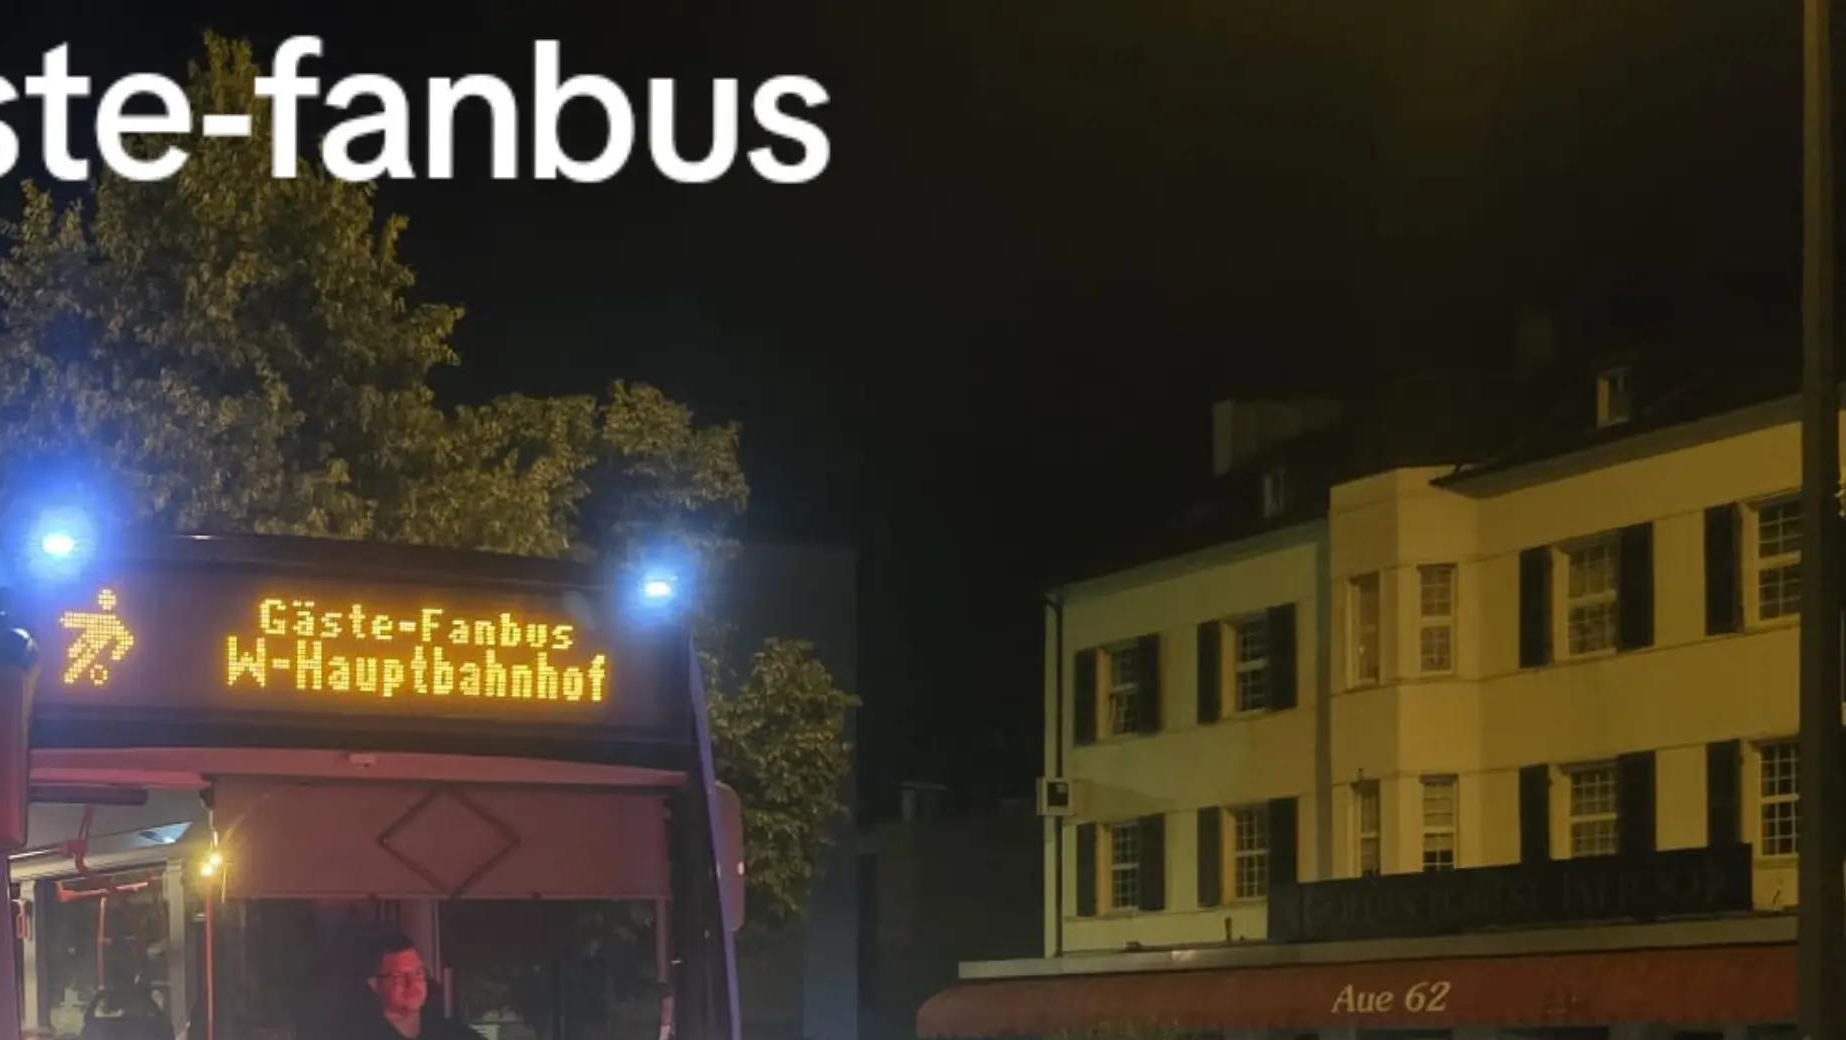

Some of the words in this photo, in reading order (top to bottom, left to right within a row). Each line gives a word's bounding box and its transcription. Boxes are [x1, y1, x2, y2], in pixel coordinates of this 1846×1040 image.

[259, 598, 574, 650] Gäste-Fanbus
[226, 635, 607, 702] W-Hauptbahnhof
[1331, 984, 1394, 1014] Aue
[1404, 981, 1451, 1013] 62
